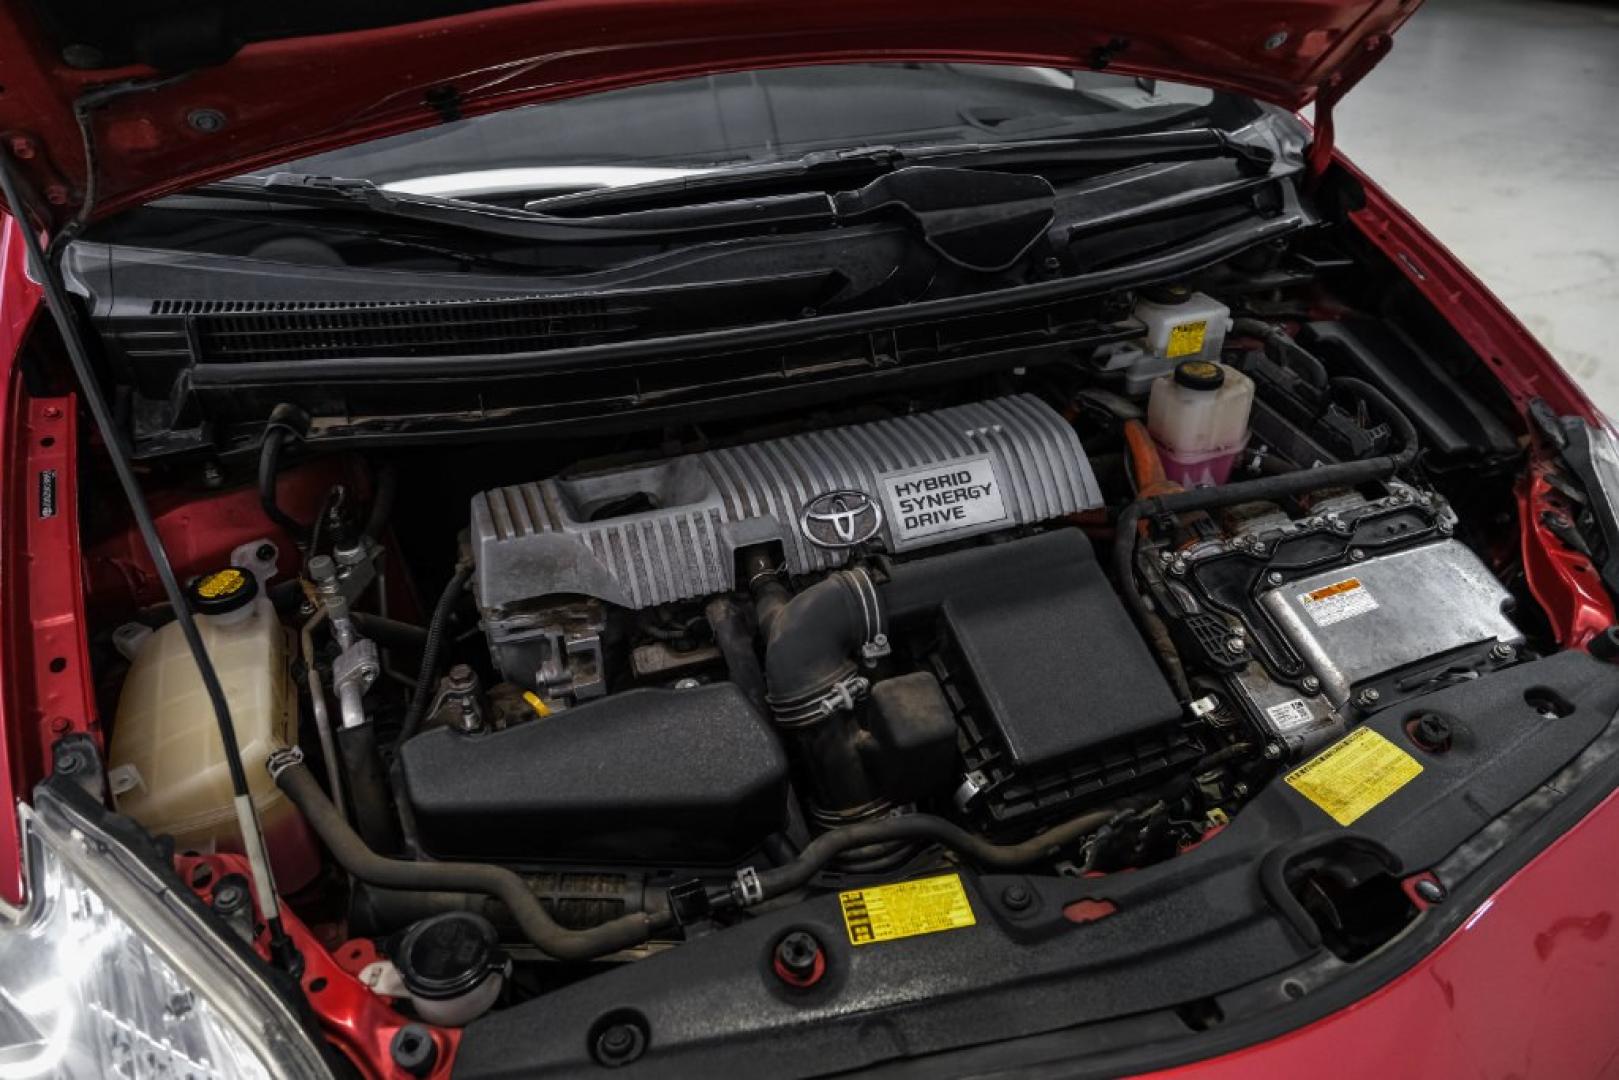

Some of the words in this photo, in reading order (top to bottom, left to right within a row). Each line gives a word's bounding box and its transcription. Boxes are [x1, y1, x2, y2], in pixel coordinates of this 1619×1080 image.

[895, 470, 972, 497] HYBRID
[900, 482, 992, 514] SYNERGY
[904, 506, 966, 530] DRIVE
